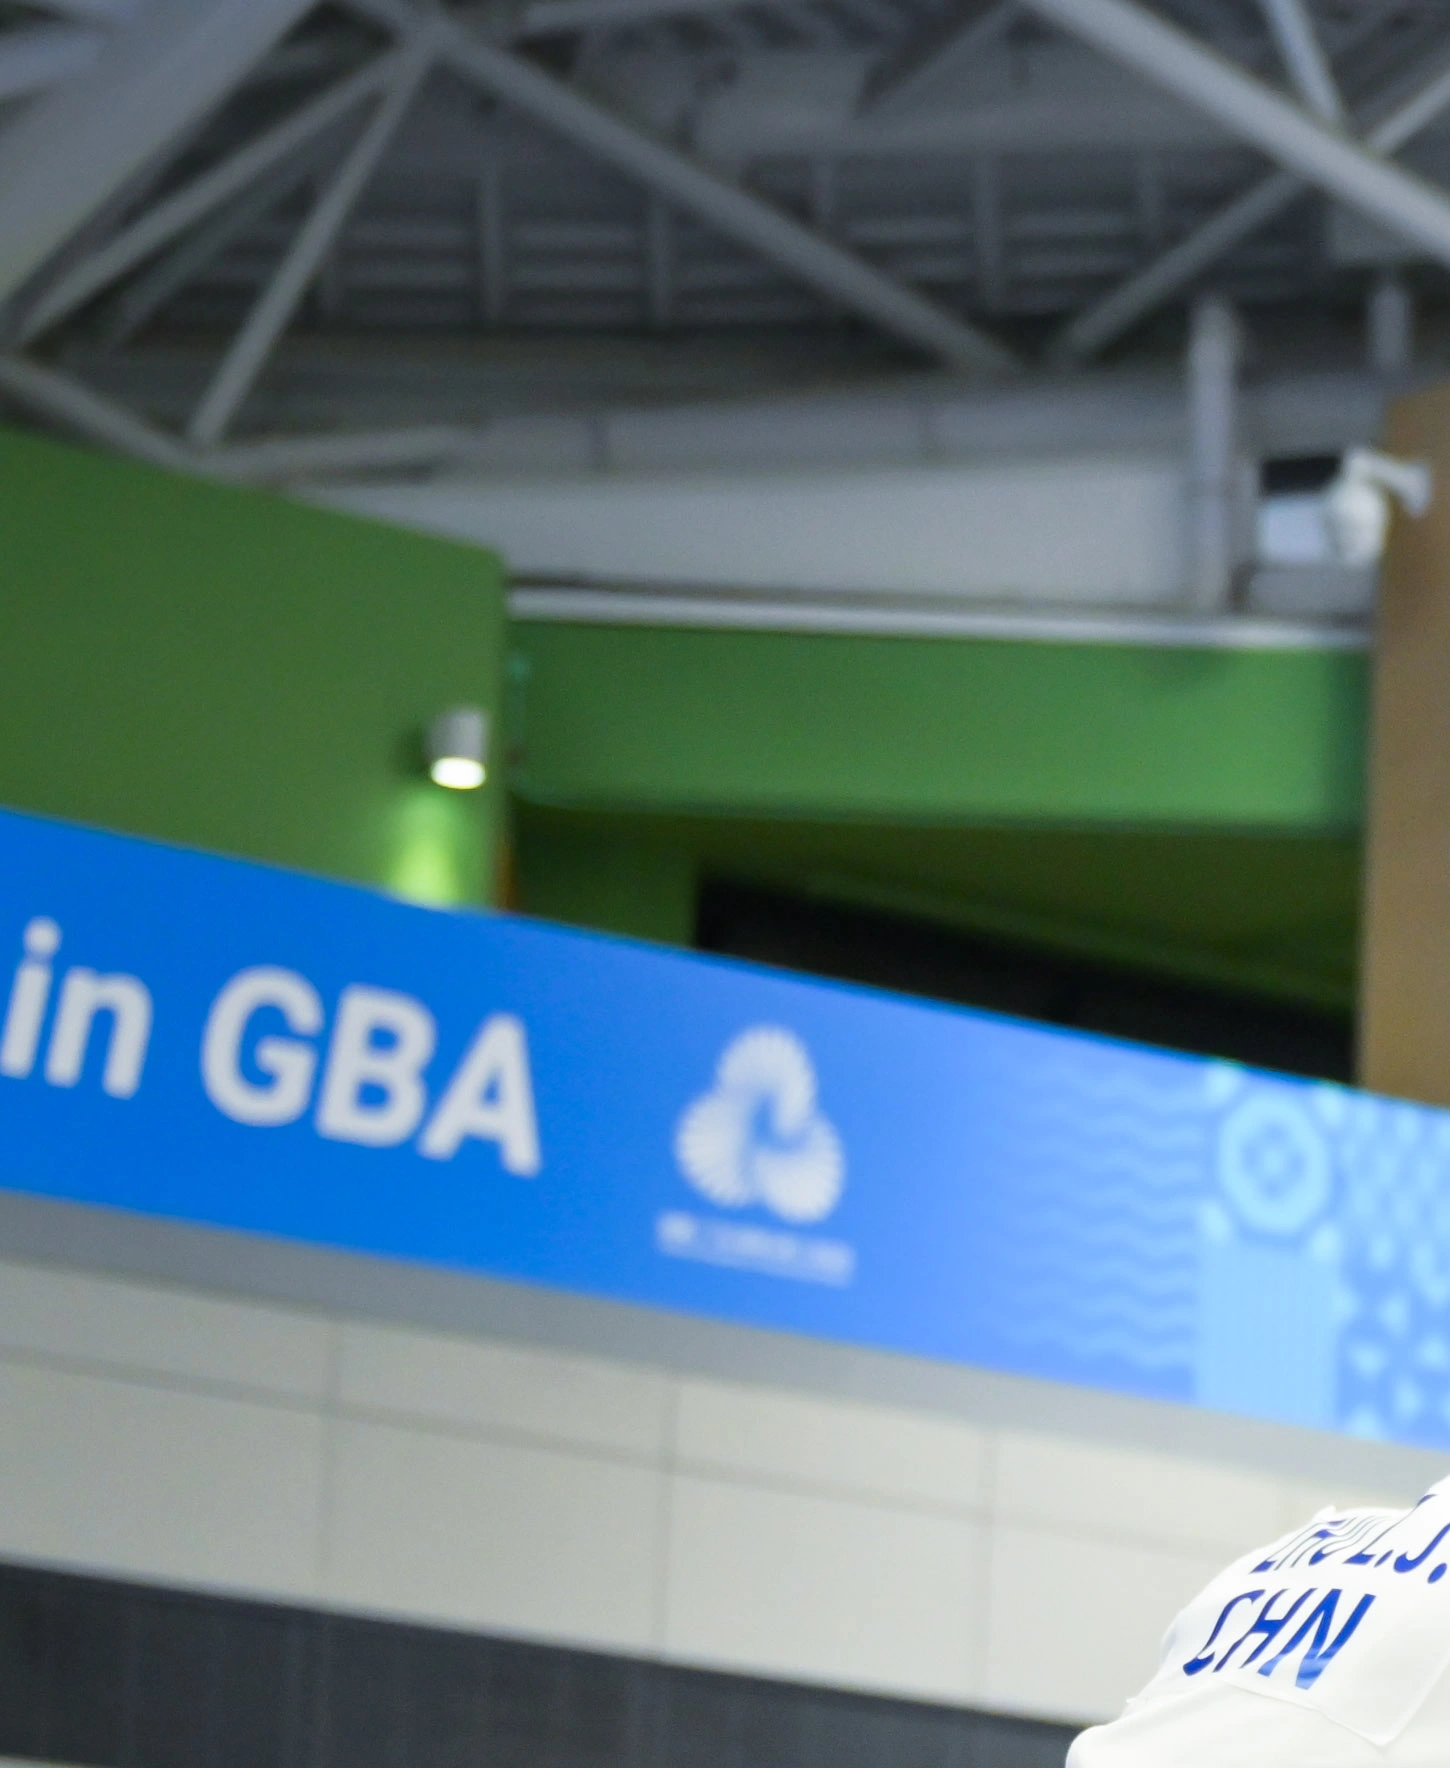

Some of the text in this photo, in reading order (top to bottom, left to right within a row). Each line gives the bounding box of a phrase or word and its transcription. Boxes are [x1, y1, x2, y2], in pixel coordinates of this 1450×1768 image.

[0, 916, 543, 1178] in GBA
[1182, 1586, 1377, 1690] CHN
